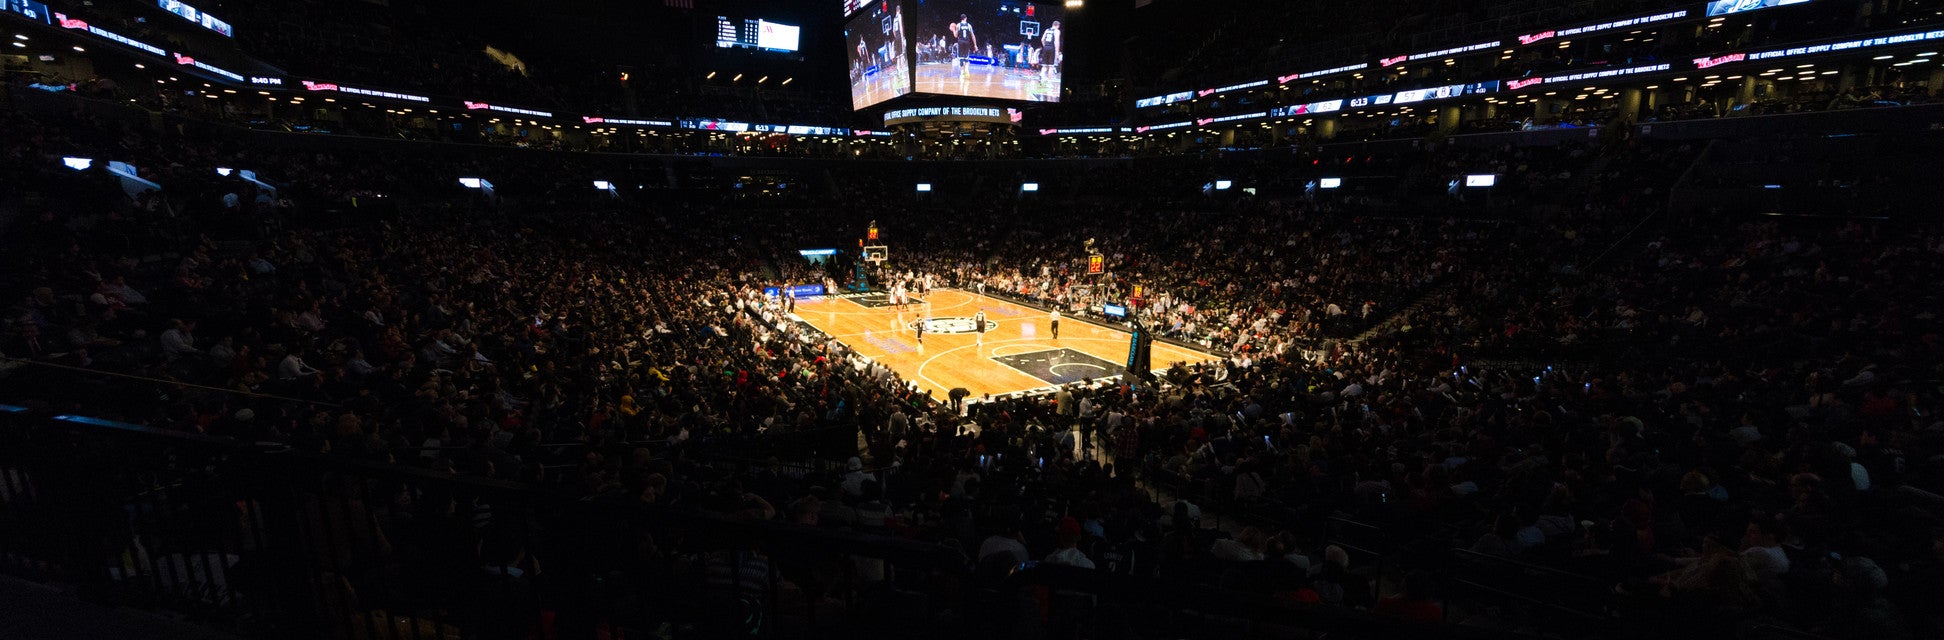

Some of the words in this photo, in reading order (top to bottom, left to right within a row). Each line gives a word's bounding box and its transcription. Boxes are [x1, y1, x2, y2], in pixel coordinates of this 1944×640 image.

[1760, 50, 1785, 58] OFFICIAL
[1787, 47, 1807, 55] OFFICE
[1807, 44, 1832, 52] SUPPLY
[1831, 41, 1863, 50] COMPANY
[1888, 33, 1926, 42] BROOKLYN
[1925, 30, 1944, 38] NETS
[1350, 97, 1368, 108] 6:13
[902, 108, 917, 118] SUPPLY
[917, 107, 943, 116] COMPANY
[942, 107, 950, 116] OF
[951, 107, 962, 116] THE
[962, 107, 988, 116] BROOKLYN
[1090, 262, 1101, 272] 22
